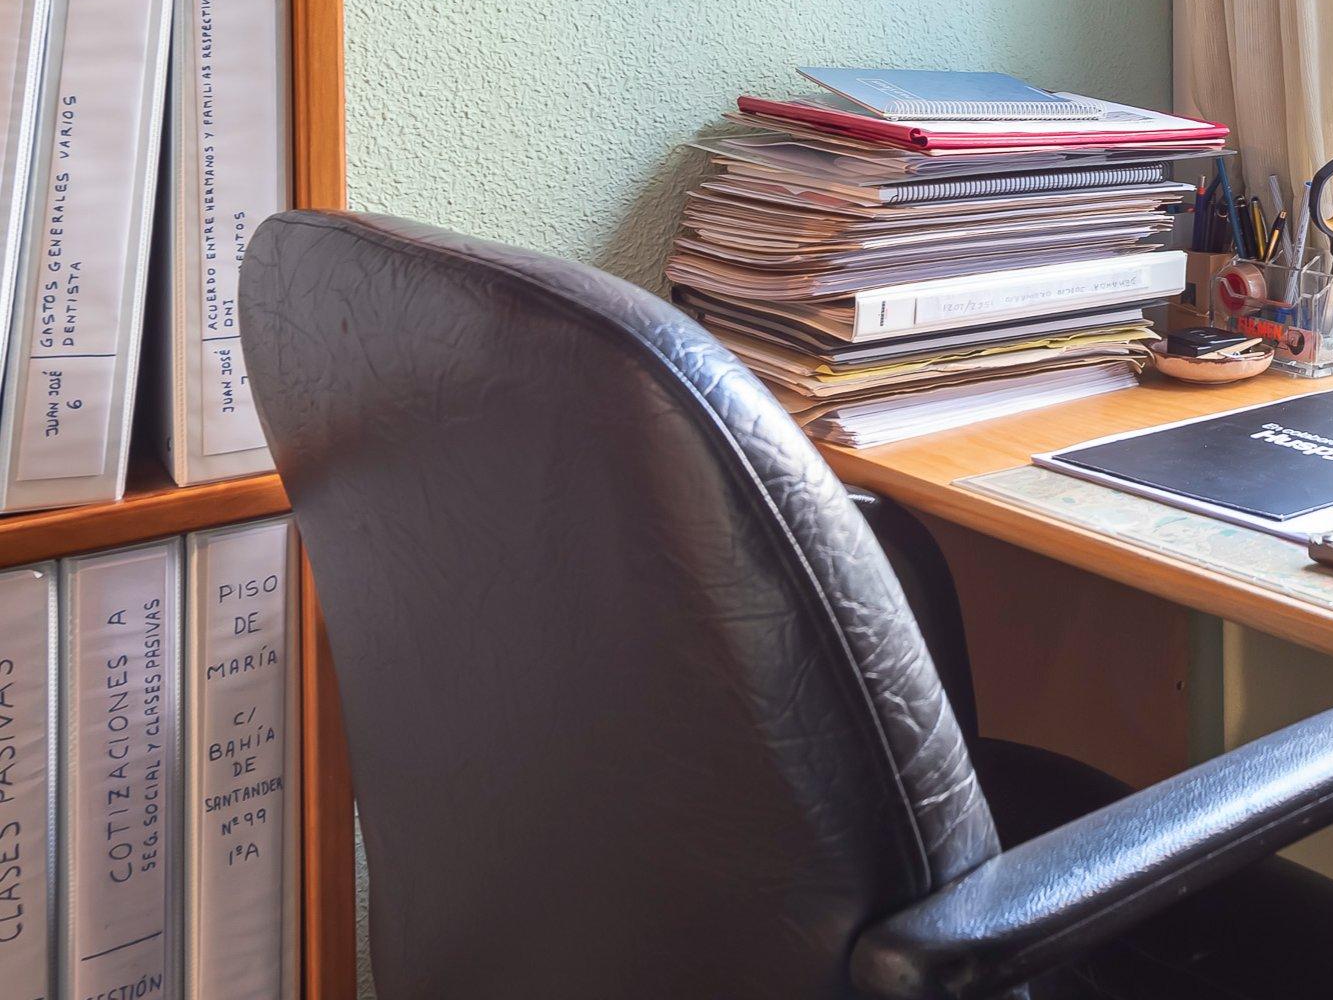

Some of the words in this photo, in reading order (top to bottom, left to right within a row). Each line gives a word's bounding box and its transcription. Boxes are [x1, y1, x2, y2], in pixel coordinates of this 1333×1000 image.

[60, 95, 77, 159] VARIOS
[204, 131, 215, 139] Y
[203, 145, 215, 212] HERMANOS
[48, 171, 69, 272] GENERALES
[204, 216, 216, 259] ENTRE
[234, 211, 246, 273] ENTOS
[39, 280, 58, 348] GASTOS
[62, 261, 82, 346] DENTISTA
[205, 267, 218, 330] ACUERDO
[223, 299, 234, 327] DNI
[219, 349, 232, 377] JOSÉ
[43, 370, 63, 396] JOSÉ
[222, 381, 235, 413] JUAN
[45, 402, 59, 437] JUAN
[218, 574, 278, 603] PISO
[107, 608, 127, 626] A
[143, 597, 161, 669] PASIVAS
[234, 612, 262, 635] DE
[207, 645, 278, 680] MARÍA
[144, 673, 161, 737] CLASES
[233, 707, 256, 726] C/
[147, 743, 161, 754] Y
[208, 726, 276, 762] BAHÍA
[106, 653, 133, 883] COTIZACIONES
[232, 757, 257, 778] DE
[143, 759, 161, 827] SOCIAL
[204, 776, 283, 813] SANTANDER
